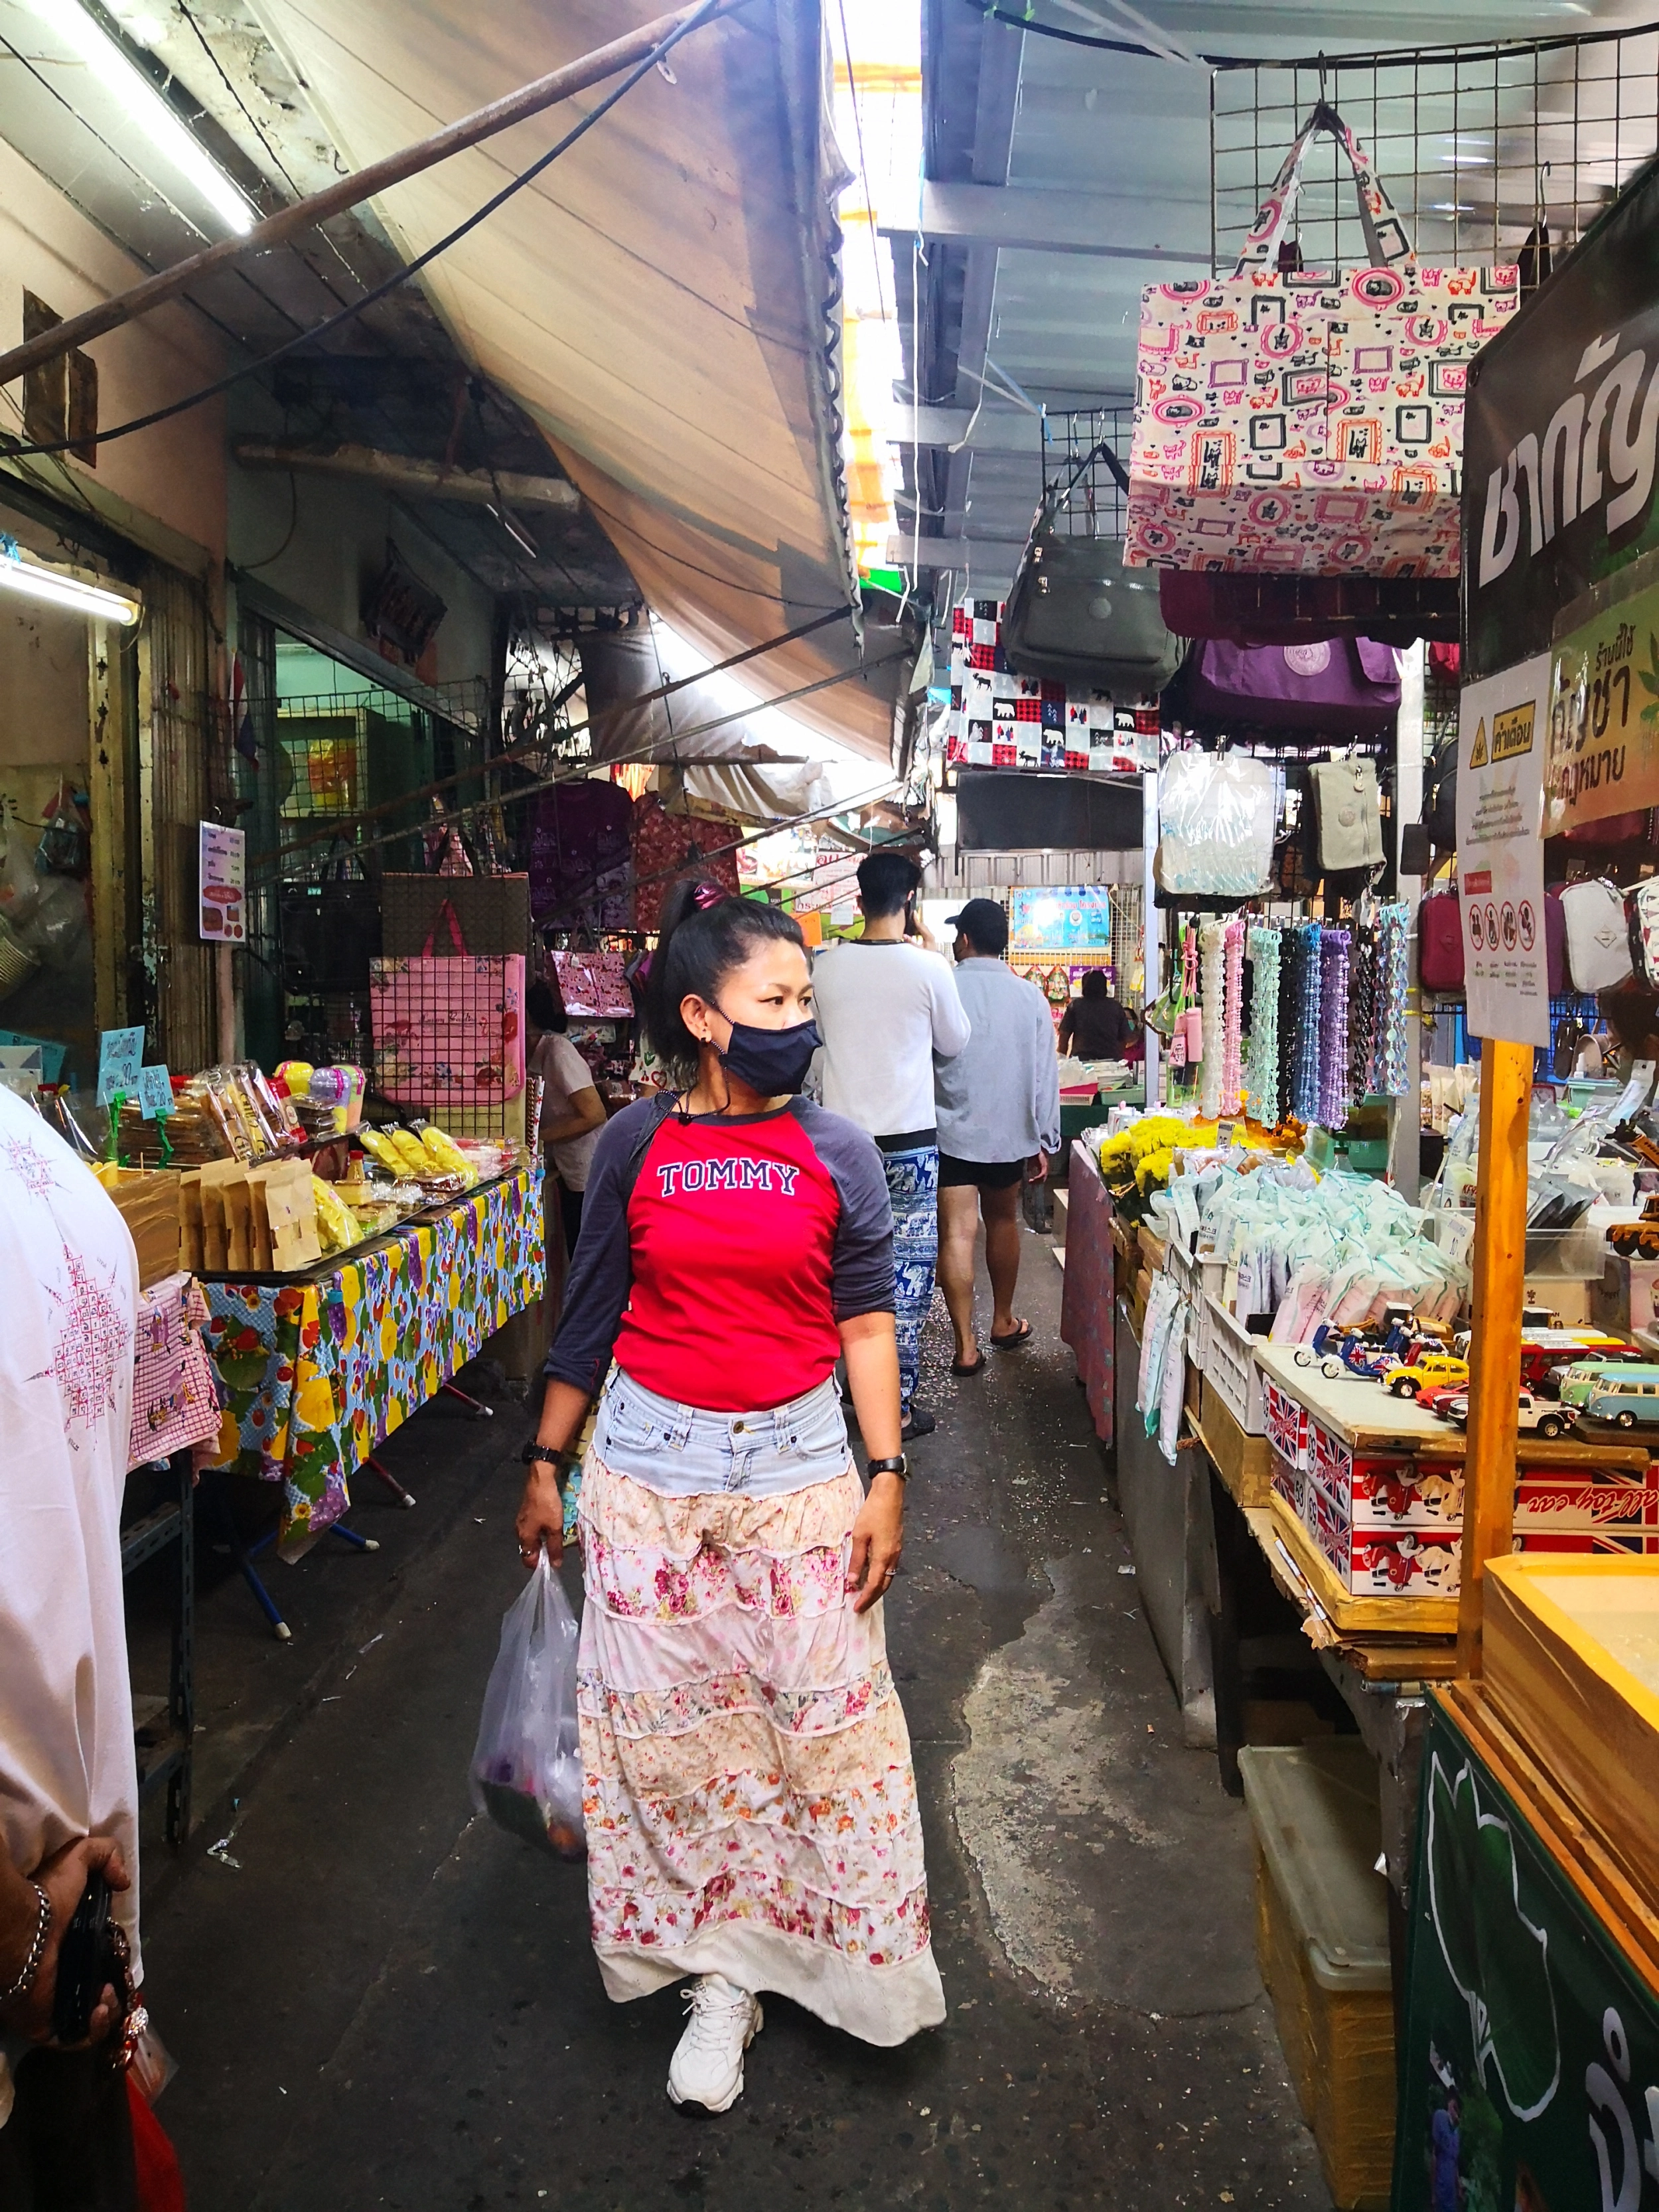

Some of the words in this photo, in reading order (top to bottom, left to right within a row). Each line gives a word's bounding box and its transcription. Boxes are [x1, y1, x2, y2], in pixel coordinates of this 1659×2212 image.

[1494, 717, 1531, 753] คำเตือน
[657, 1157, 799, 1197] TOMMY
[1527, 1495, 1569, 1514] car
[1575, 1487, 1617, 1515] toy
